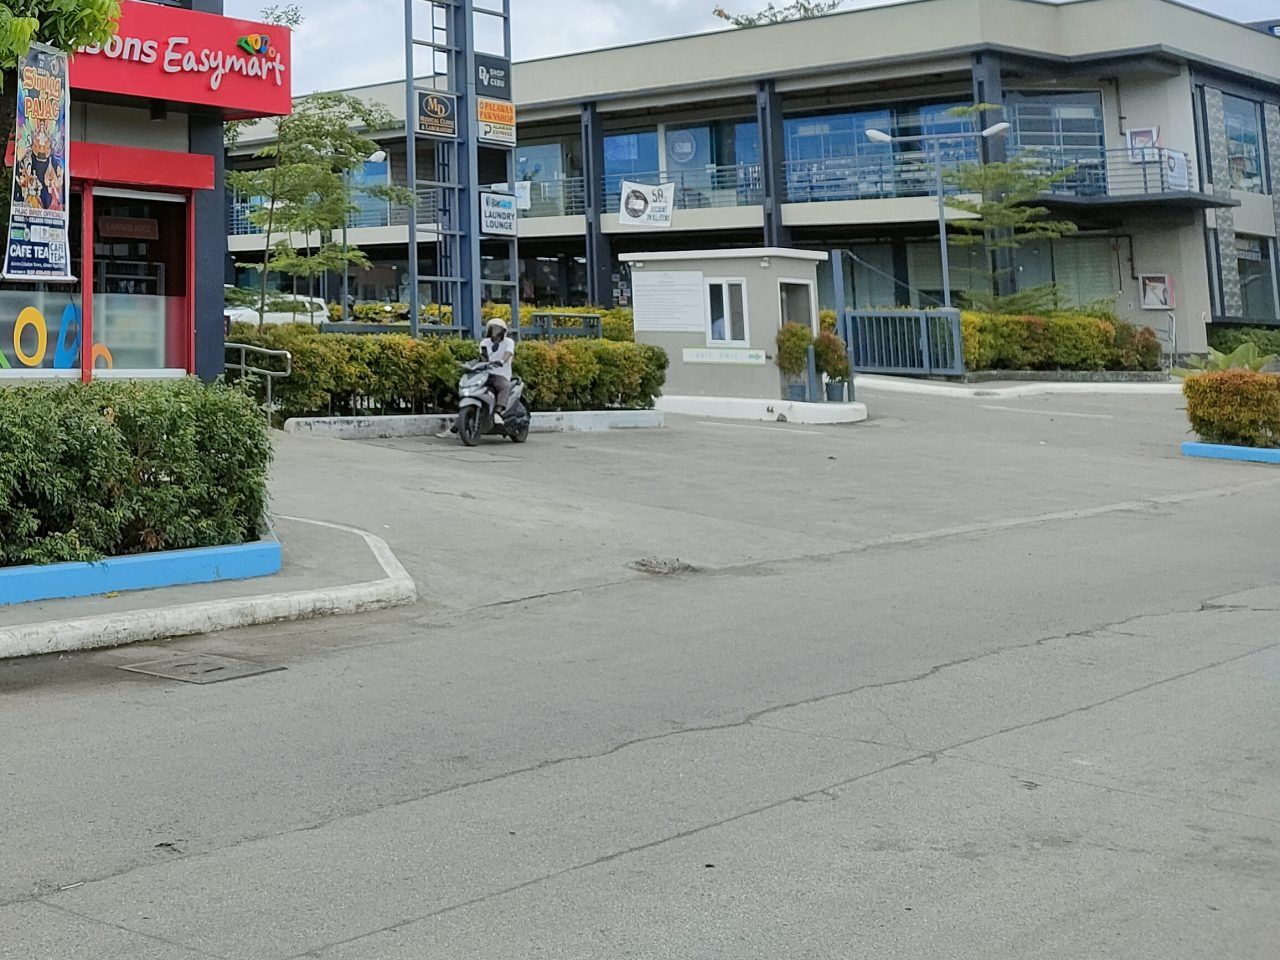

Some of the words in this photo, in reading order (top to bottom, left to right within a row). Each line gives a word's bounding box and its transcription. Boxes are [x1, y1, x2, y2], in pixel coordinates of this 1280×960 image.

[163, 36, 286, 90] Easymart
[489, 68, 505, 77] SHOP
[489, 78, 505, 87] CEBU
[24, 96, 60, 120] PAJAC
[426, 97, 446, 116] MD
[484, 102, 513, 115] PALAWAN
[479, 111, 514, 124] PAWNSHOP
[484, 210, 515, 220] LAUNDRY
[485, 220, 513, 230] LOUNGE
[10, 244, 32, 258] CAFE
[33, 245, 49, 258] TEA
